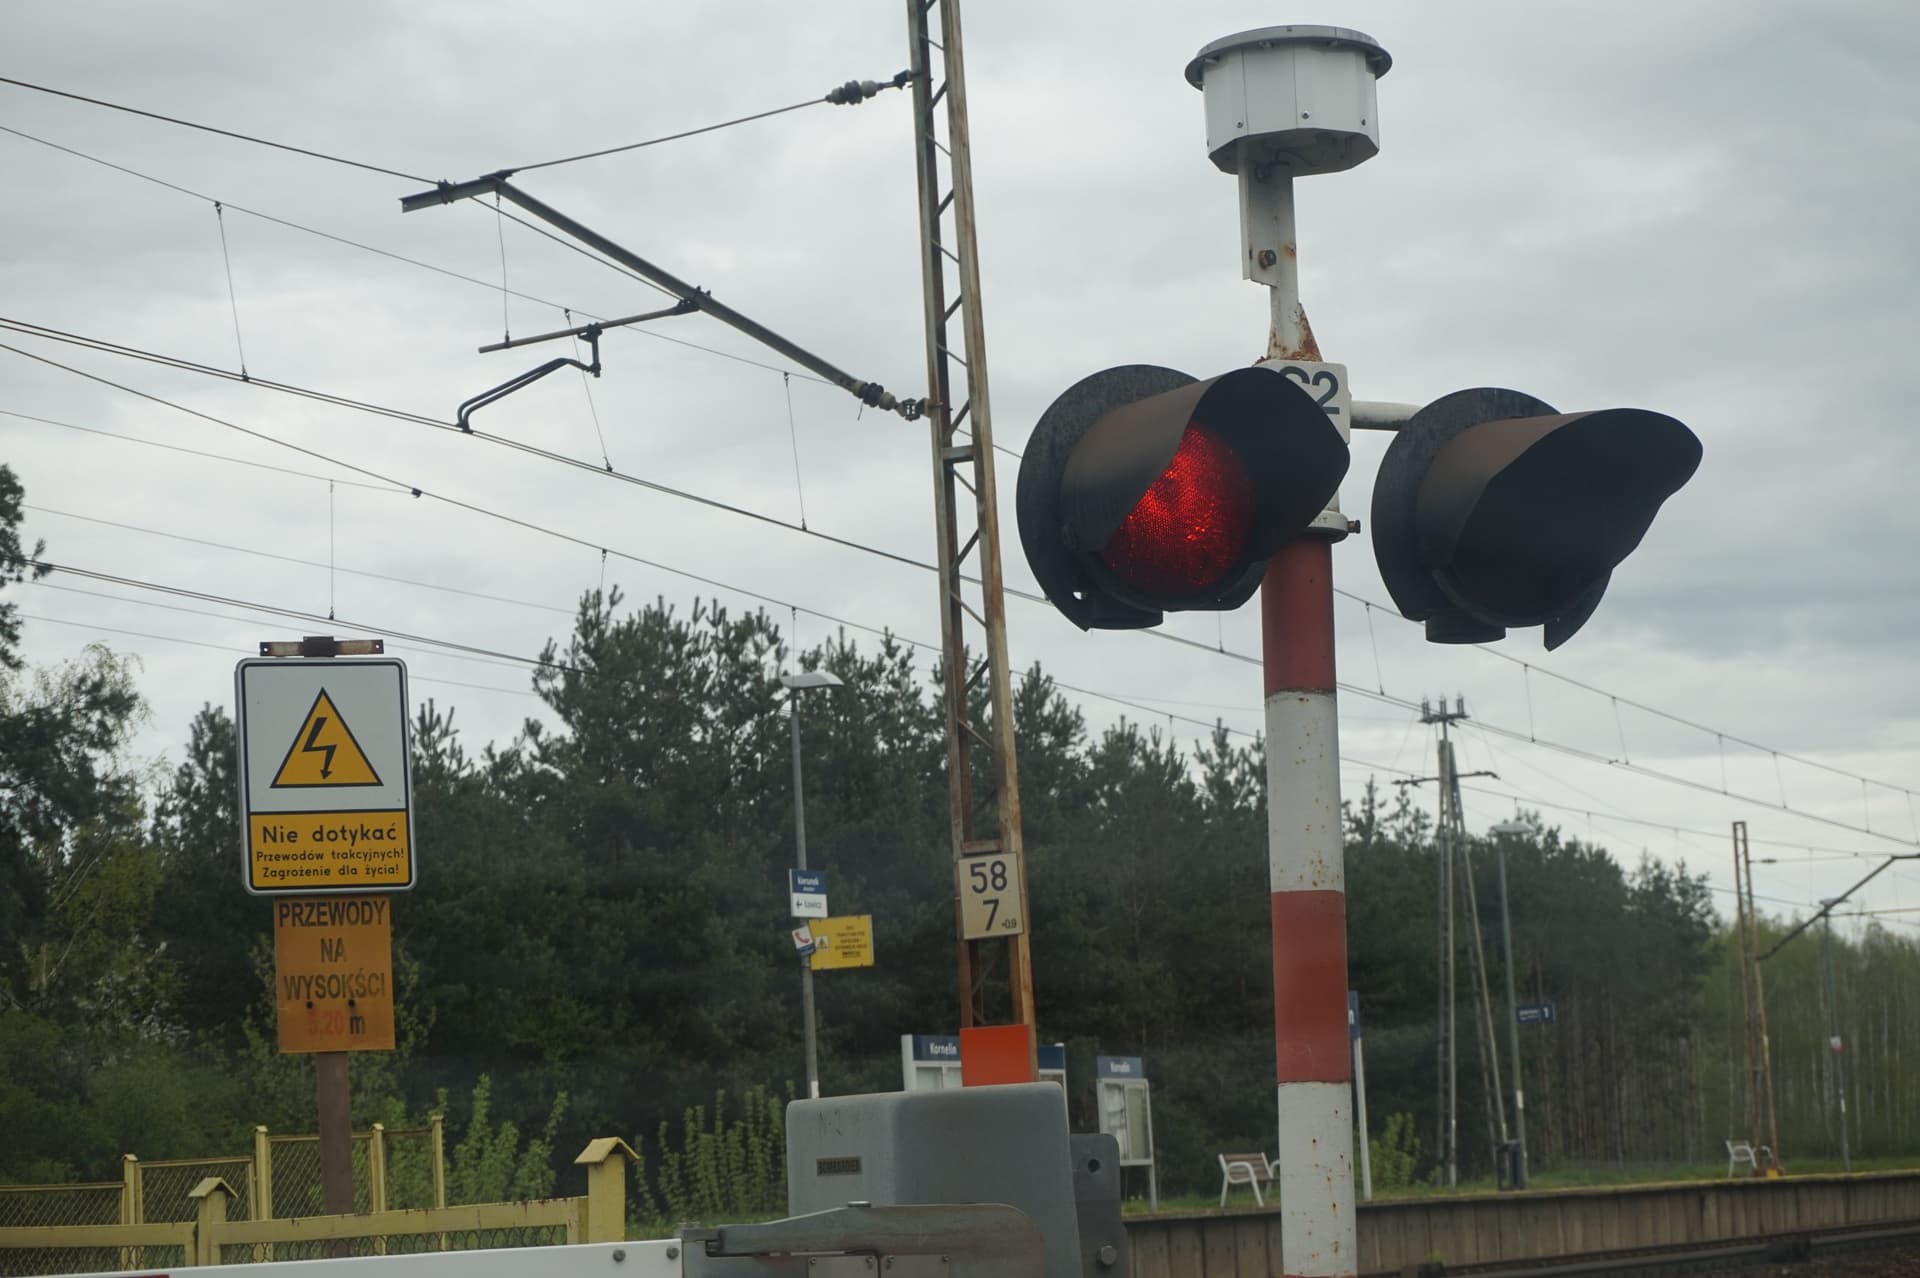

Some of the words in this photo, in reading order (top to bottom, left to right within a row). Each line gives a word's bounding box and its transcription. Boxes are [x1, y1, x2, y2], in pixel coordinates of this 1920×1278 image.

[263, 825, 298, 843] Nie
[312, 823, 397, 846] dotykać
[256, 850, 324, 862] Przewodów
[331, 848, 404, 861] trakcyjnych!
[262, 866, 331, 880] Zagrożenie
[338, 865, 358, 876] dla
[365, 864, 399, 878] życia!
[970, 860, 1008, 894] 58
[279, 900, 386, 928] PRZEWODY
[982, 898, 1000, 931] 7
[320, 937, 347, 963] NA
[349, 1015, 366, 1035] m
